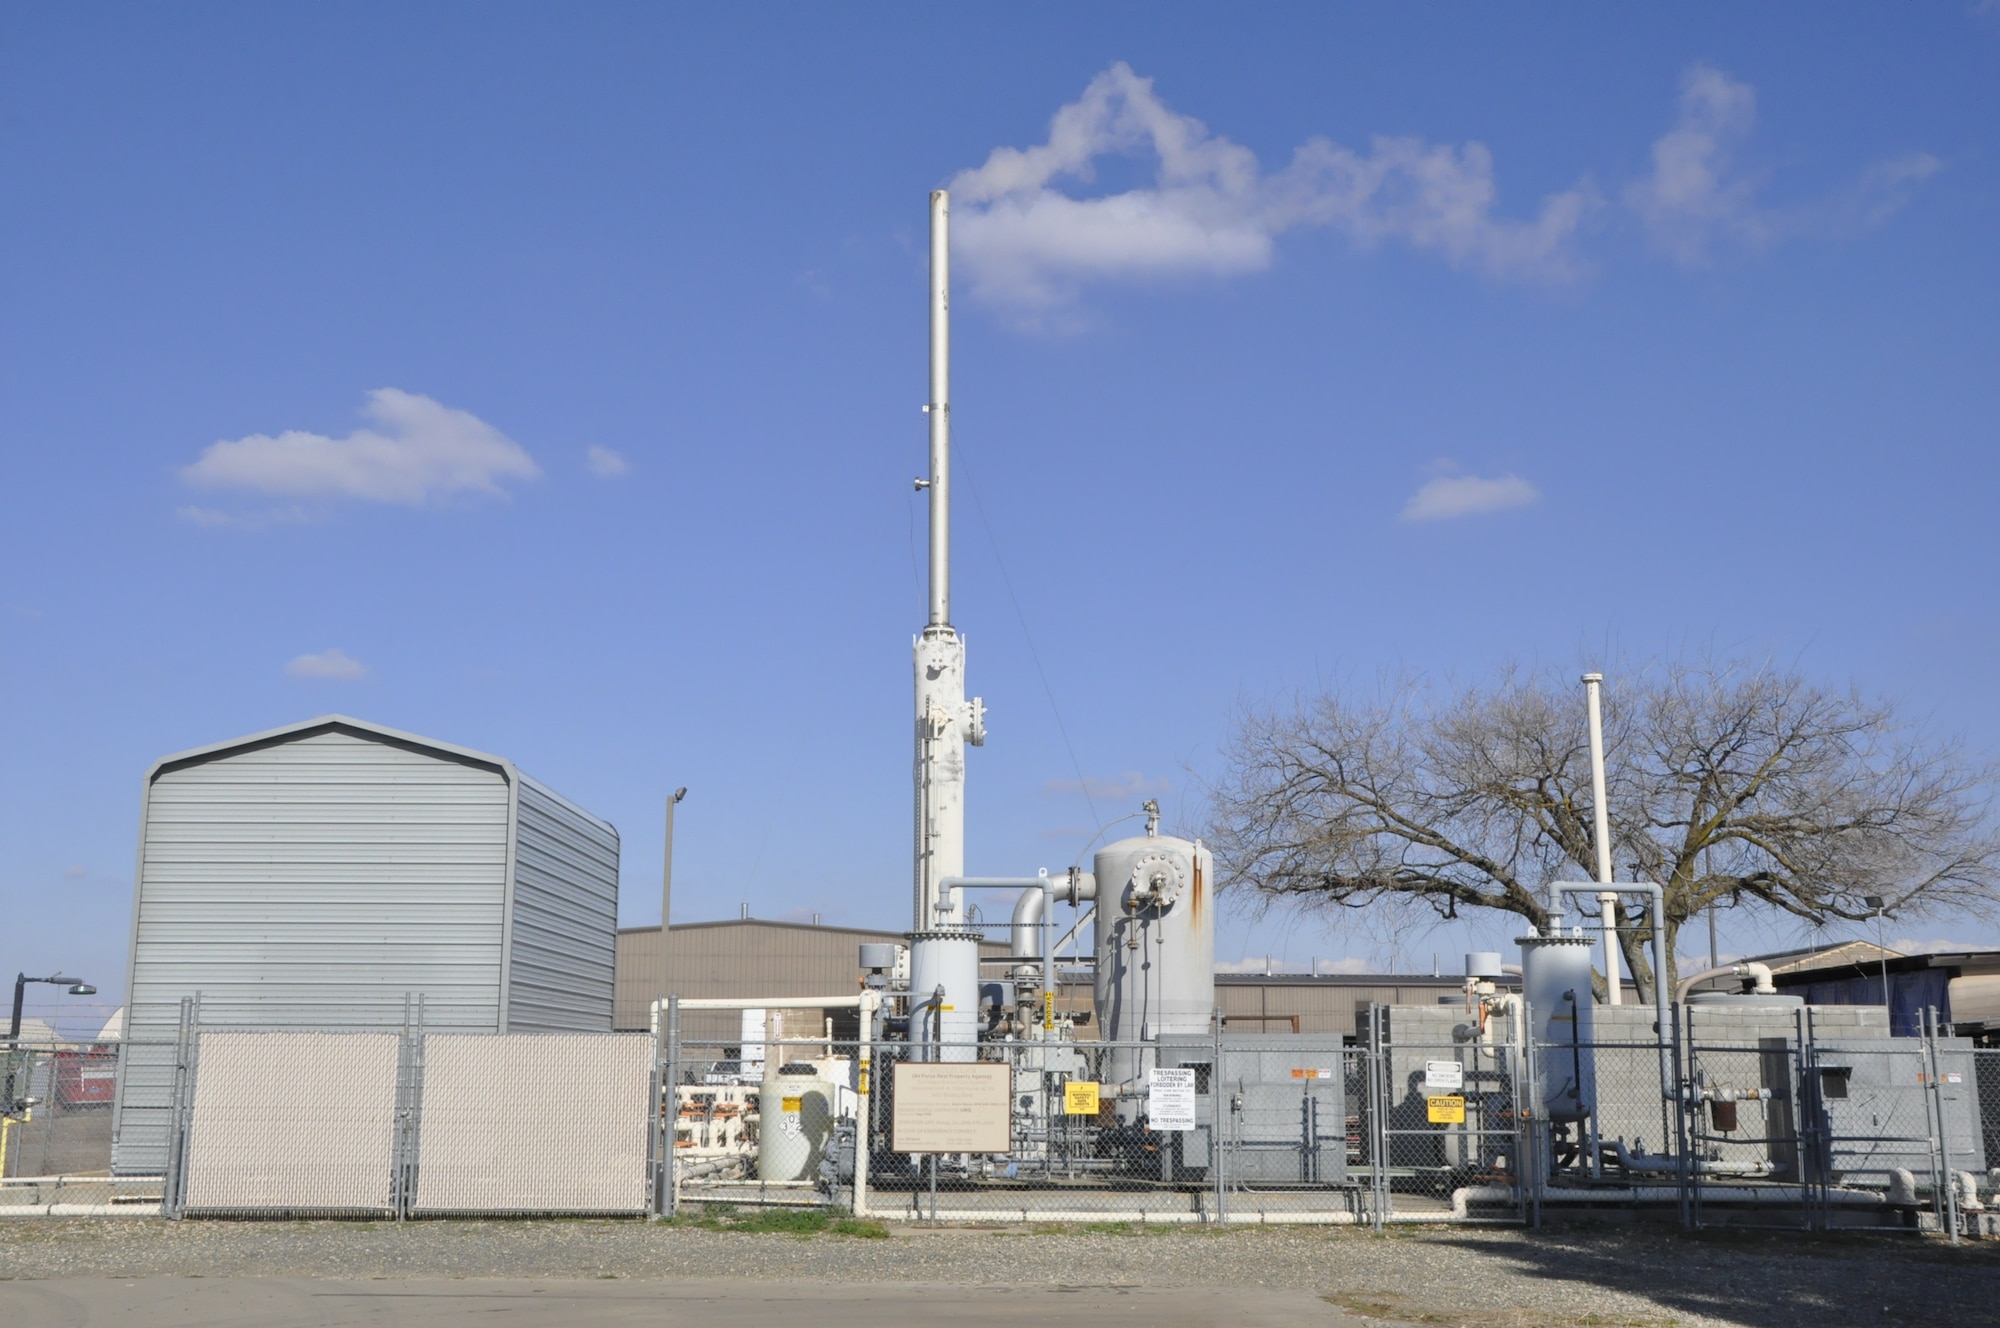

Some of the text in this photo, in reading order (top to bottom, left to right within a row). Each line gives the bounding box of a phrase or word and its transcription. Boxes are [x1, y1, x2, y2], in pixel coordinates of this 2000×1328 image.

[788, 1114, 795, 1124] 0
[782, 1122, 788, 1131] 3
[796, 1122, 803, 1131] 2
